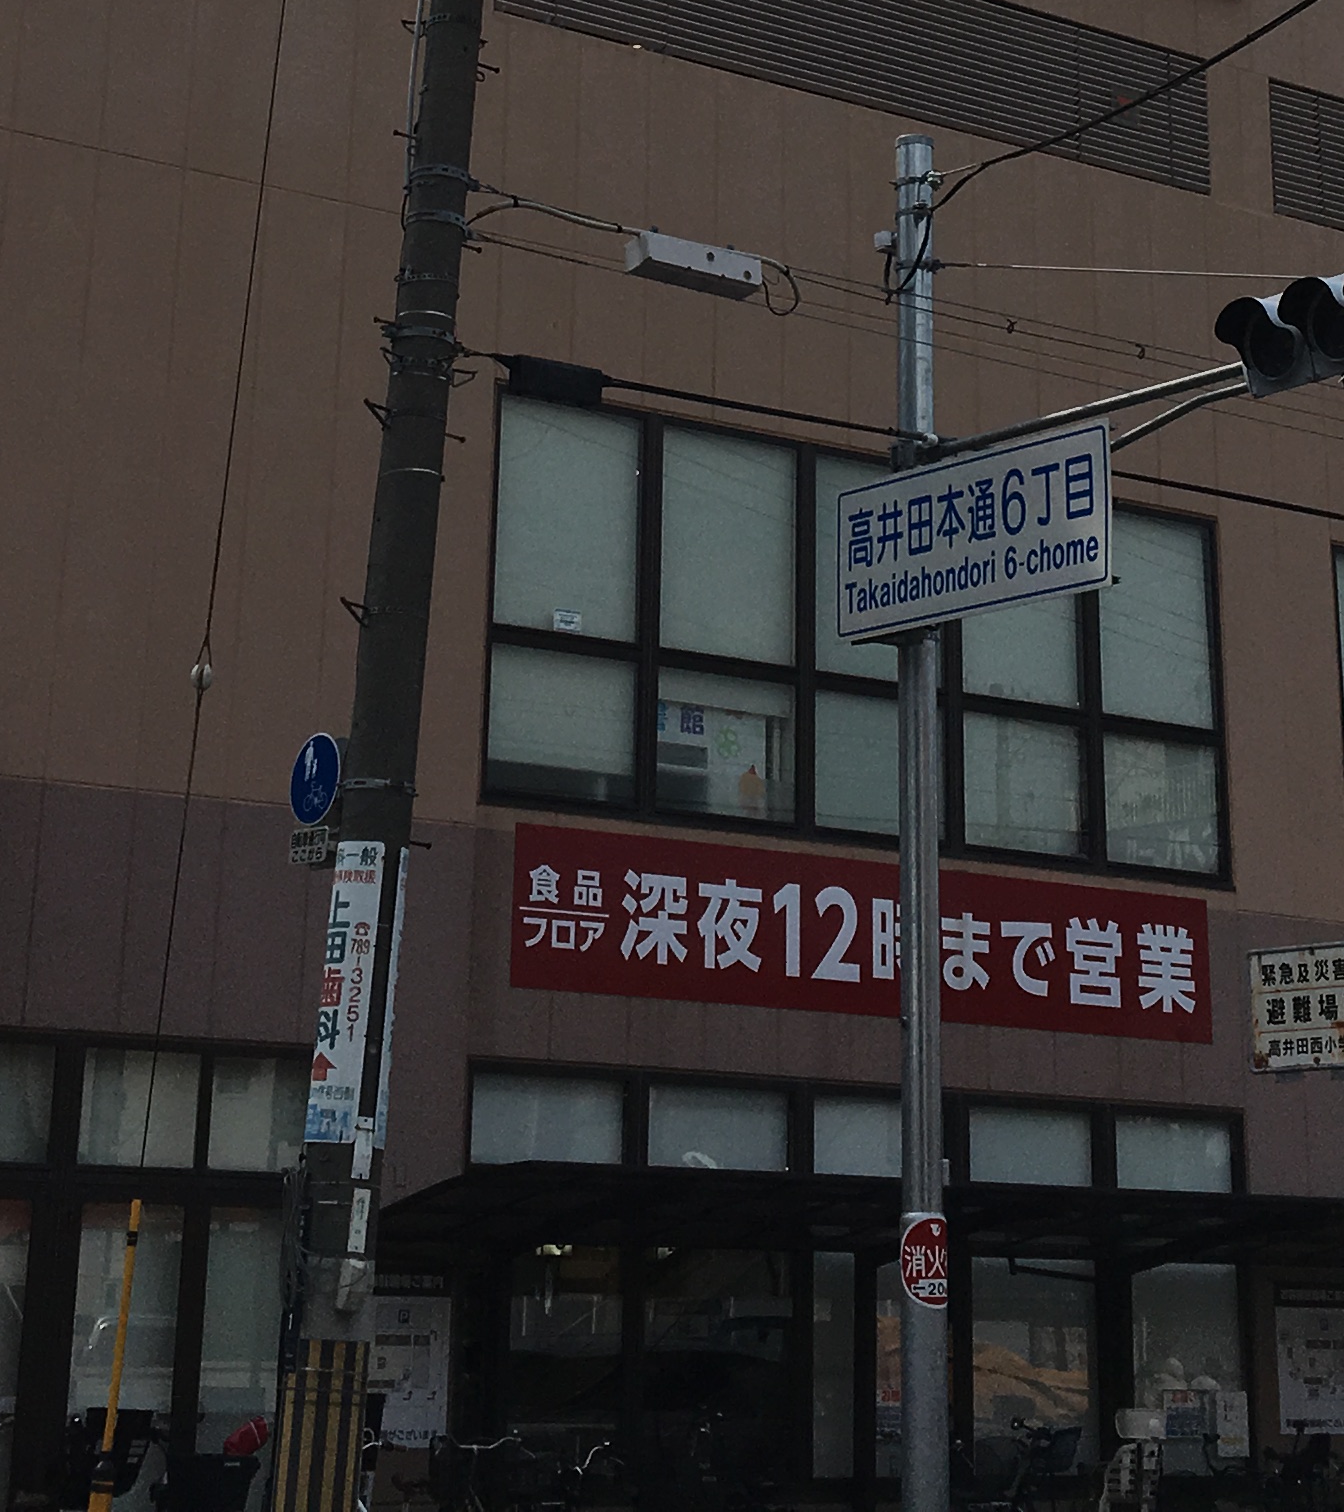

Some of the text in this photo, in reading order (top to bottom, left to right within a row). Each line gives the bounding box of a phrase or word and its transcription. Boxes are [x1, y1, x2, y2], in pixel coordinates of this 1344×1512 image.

[847, 453, 1094, 572] 高井田本通6丁目
[845, 535, 1099, 615] Takaidahondori 6-chome
[292, 847, 323, 863] ここから
[527, 863, 603, 906] 食品
[522, 916, 606, 952] フロア
[904, 1244, 948, 1278] 消火
[928, 1281, 947, 1296] 20
